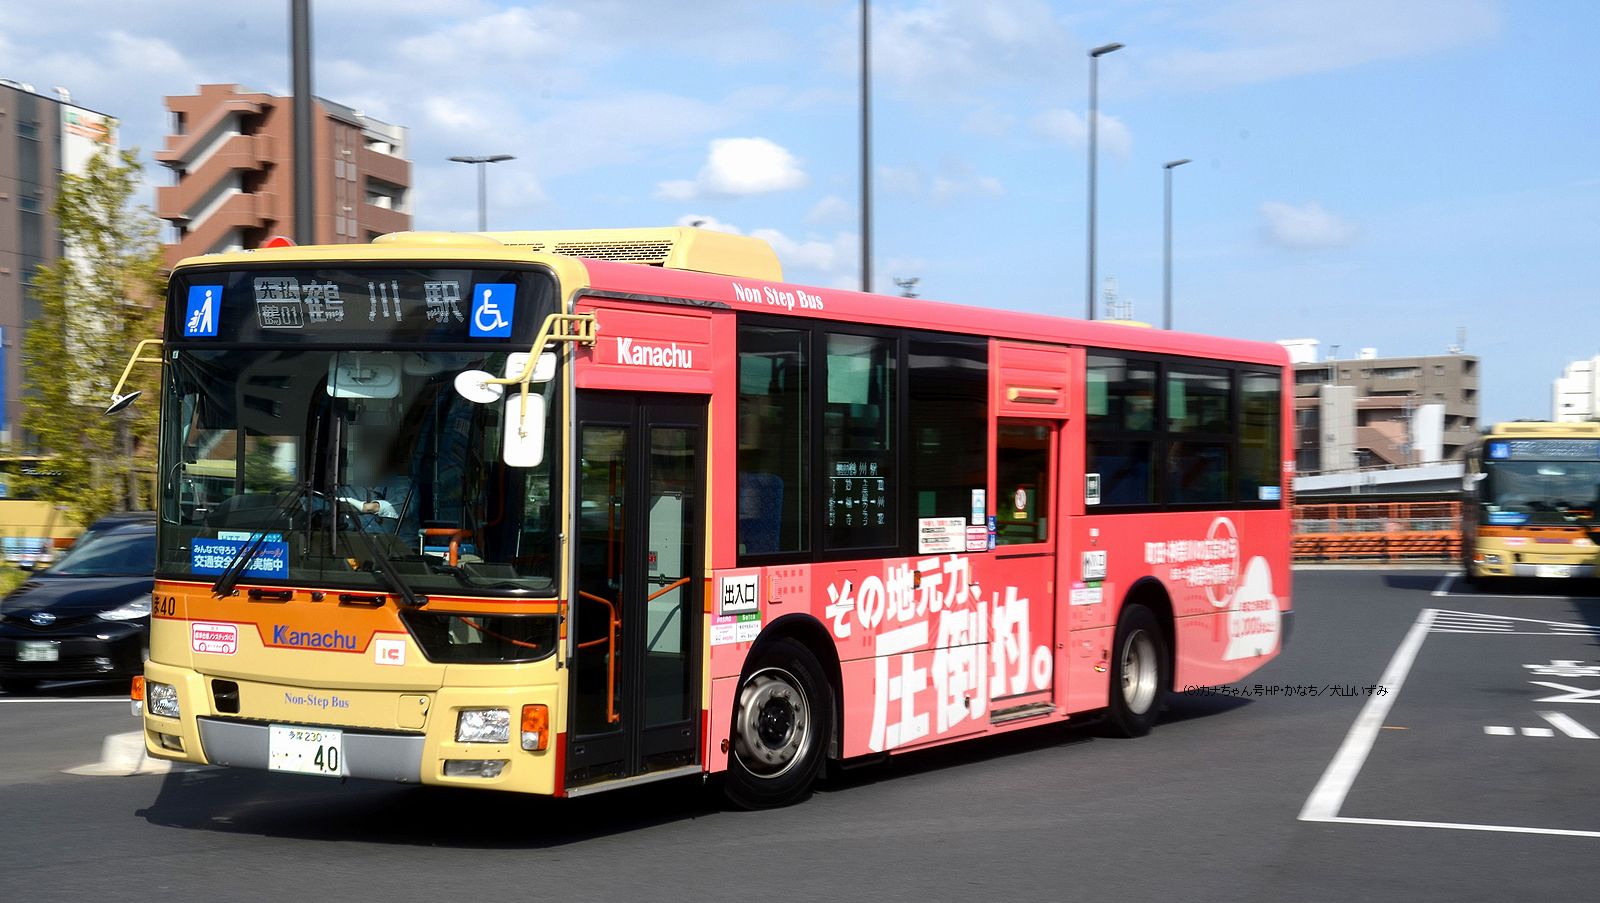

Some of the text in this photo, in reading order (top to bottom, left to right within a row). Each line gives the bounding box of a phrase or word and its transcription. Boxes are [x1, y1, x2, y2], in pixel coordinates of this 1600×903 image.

[260, 281, 296, 299] 先払
[732, 282, 824, 311] Non Step Bus
[617, 337, 692, 369] Kanachu
[724, 583, 755, 606] 出入口
[825, 554, 983, 639] その地元力、
[273, 625, 356, 650] Kanachu
[868, 586, 1053, 753] 圧倒的。
[284, 693, 350, 709] Non-Step Bus
[314, 744, 338, 771] 40
